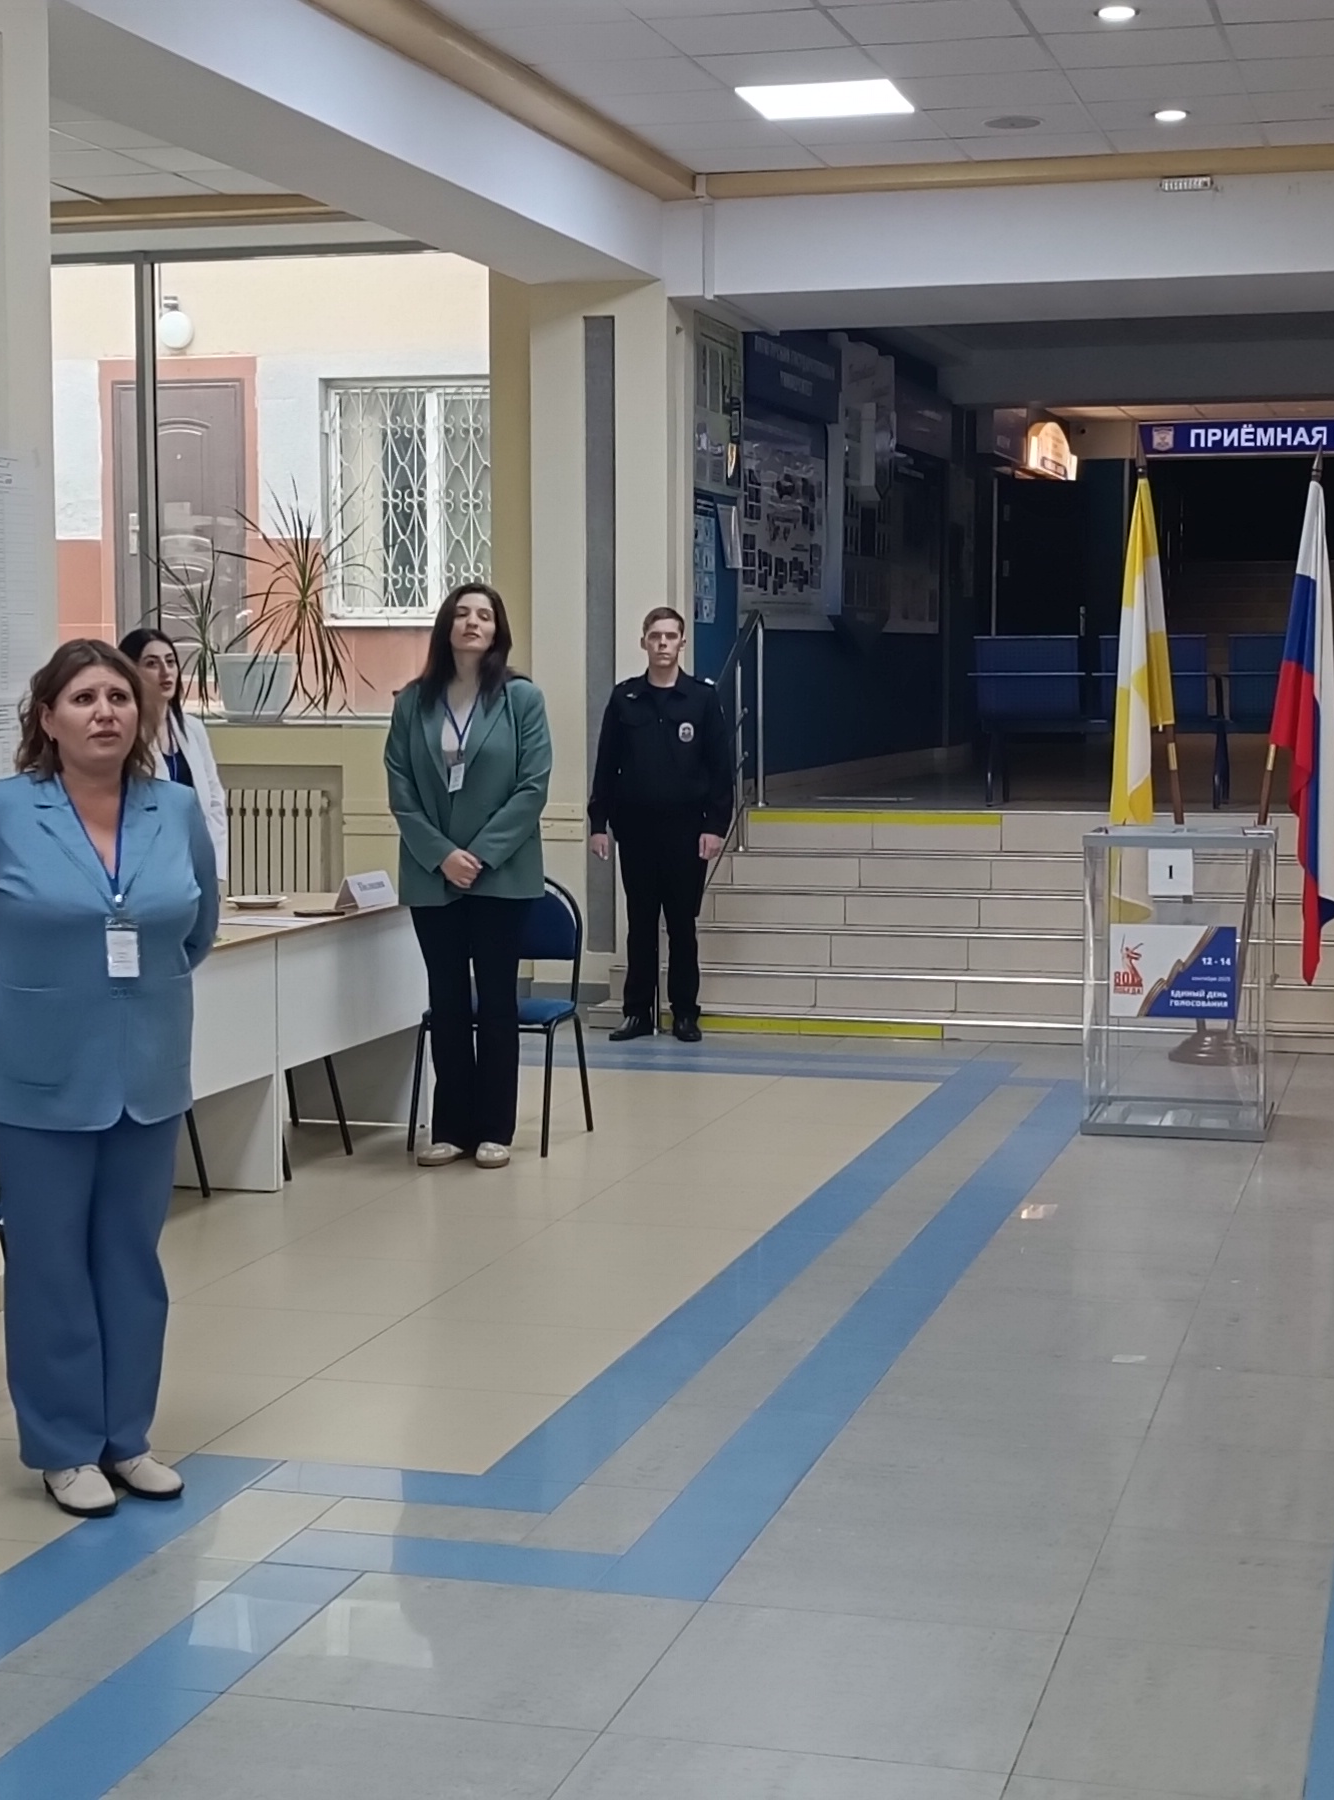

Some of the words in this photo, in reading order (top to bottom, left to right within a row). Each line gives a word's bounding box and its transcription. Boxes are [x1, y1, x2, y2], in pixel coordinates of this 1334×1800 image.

[1189, 423, 1328, 448] ПРИЁМНАЯ
[1168, 864, 1174, 880] 1
[1220, 957, 1231, 966] 14
[1206, 990, 1227, 999] ДЕНЬ
[1169, 998, 1228, 1008] ГОЛОСОВАНИЯ
